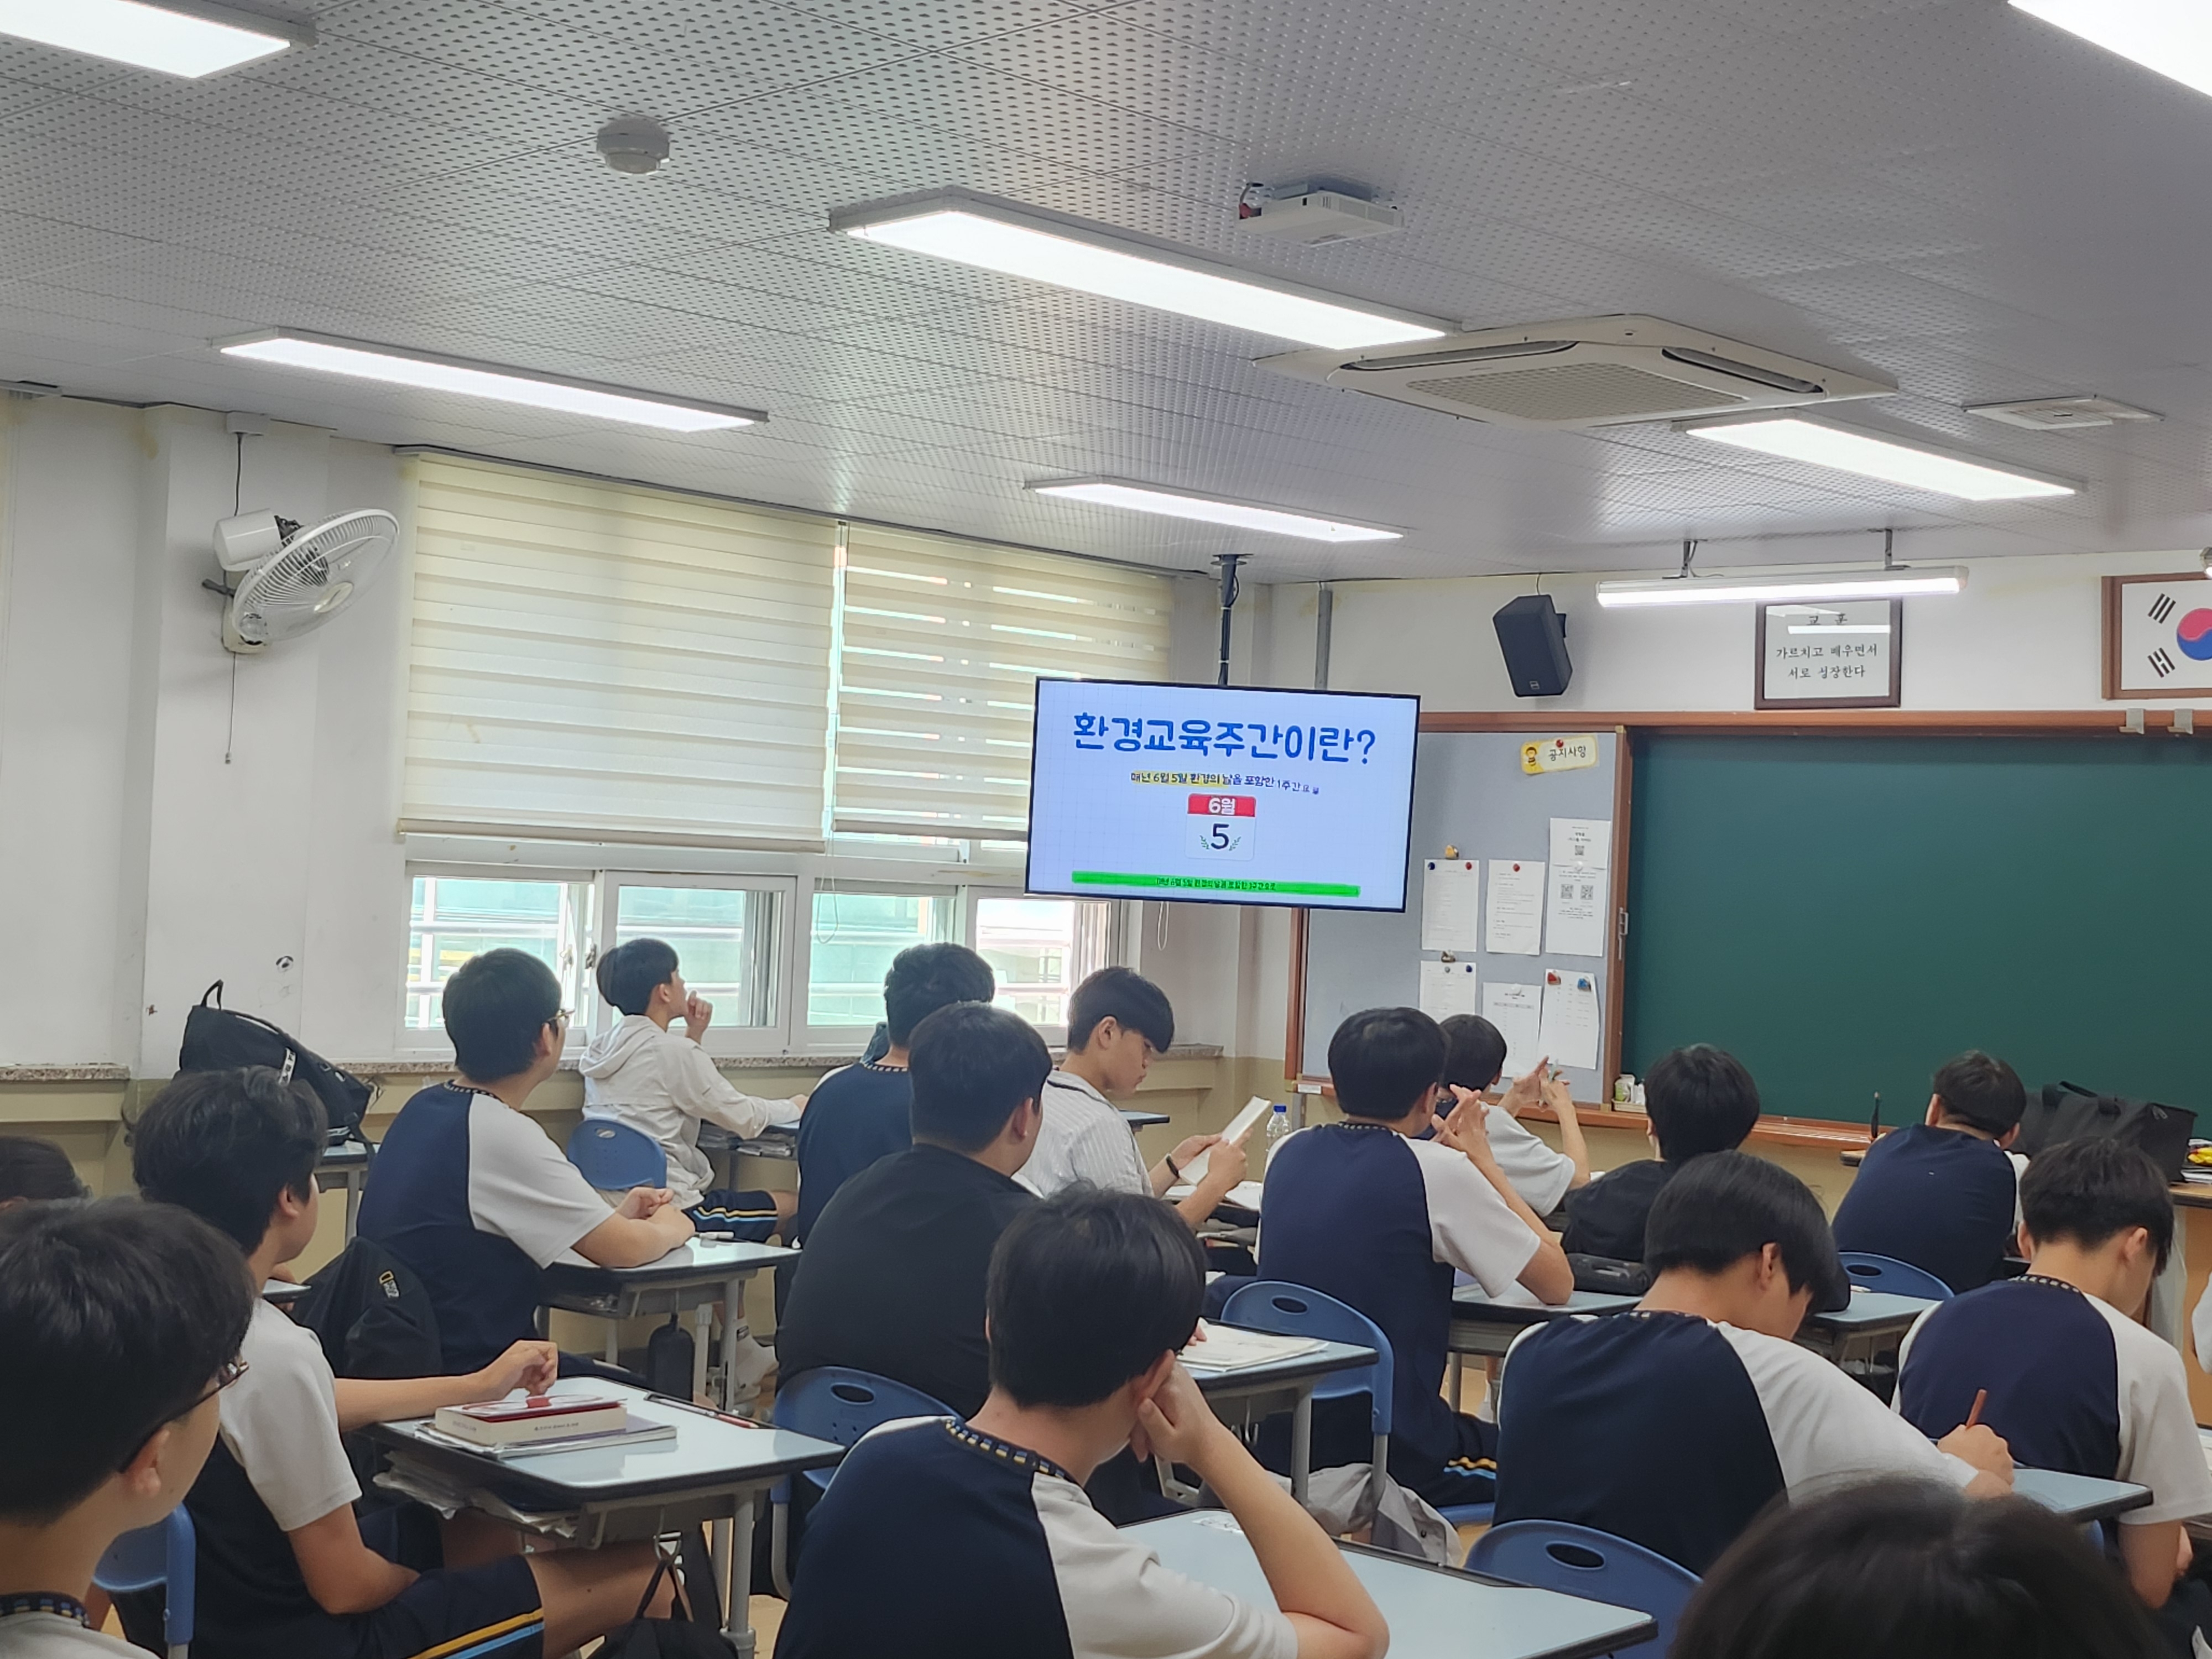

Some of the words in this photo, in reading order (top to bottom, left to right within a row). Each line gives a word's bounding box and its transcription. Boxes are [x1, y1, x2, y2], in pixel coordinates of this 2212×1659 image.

[1776, 646, 1824, 660] 가르치고
[1830, 643, 1878, 658] 배우면서
[1788, 667, 1811, 680] 서로
[1818, 664, 1866, 679] 성장한다
[1073, 712, 1376, 765] 환경교육주간이란?
[1548, 745, 1587, 762] 공지사항
[1130, 773, 1151, 783] 매년
[1190, 773, 1220, 785] 환경의
[1208, 797, 1236, 815] 6월
[1211, 823, 1230, 850] 5
